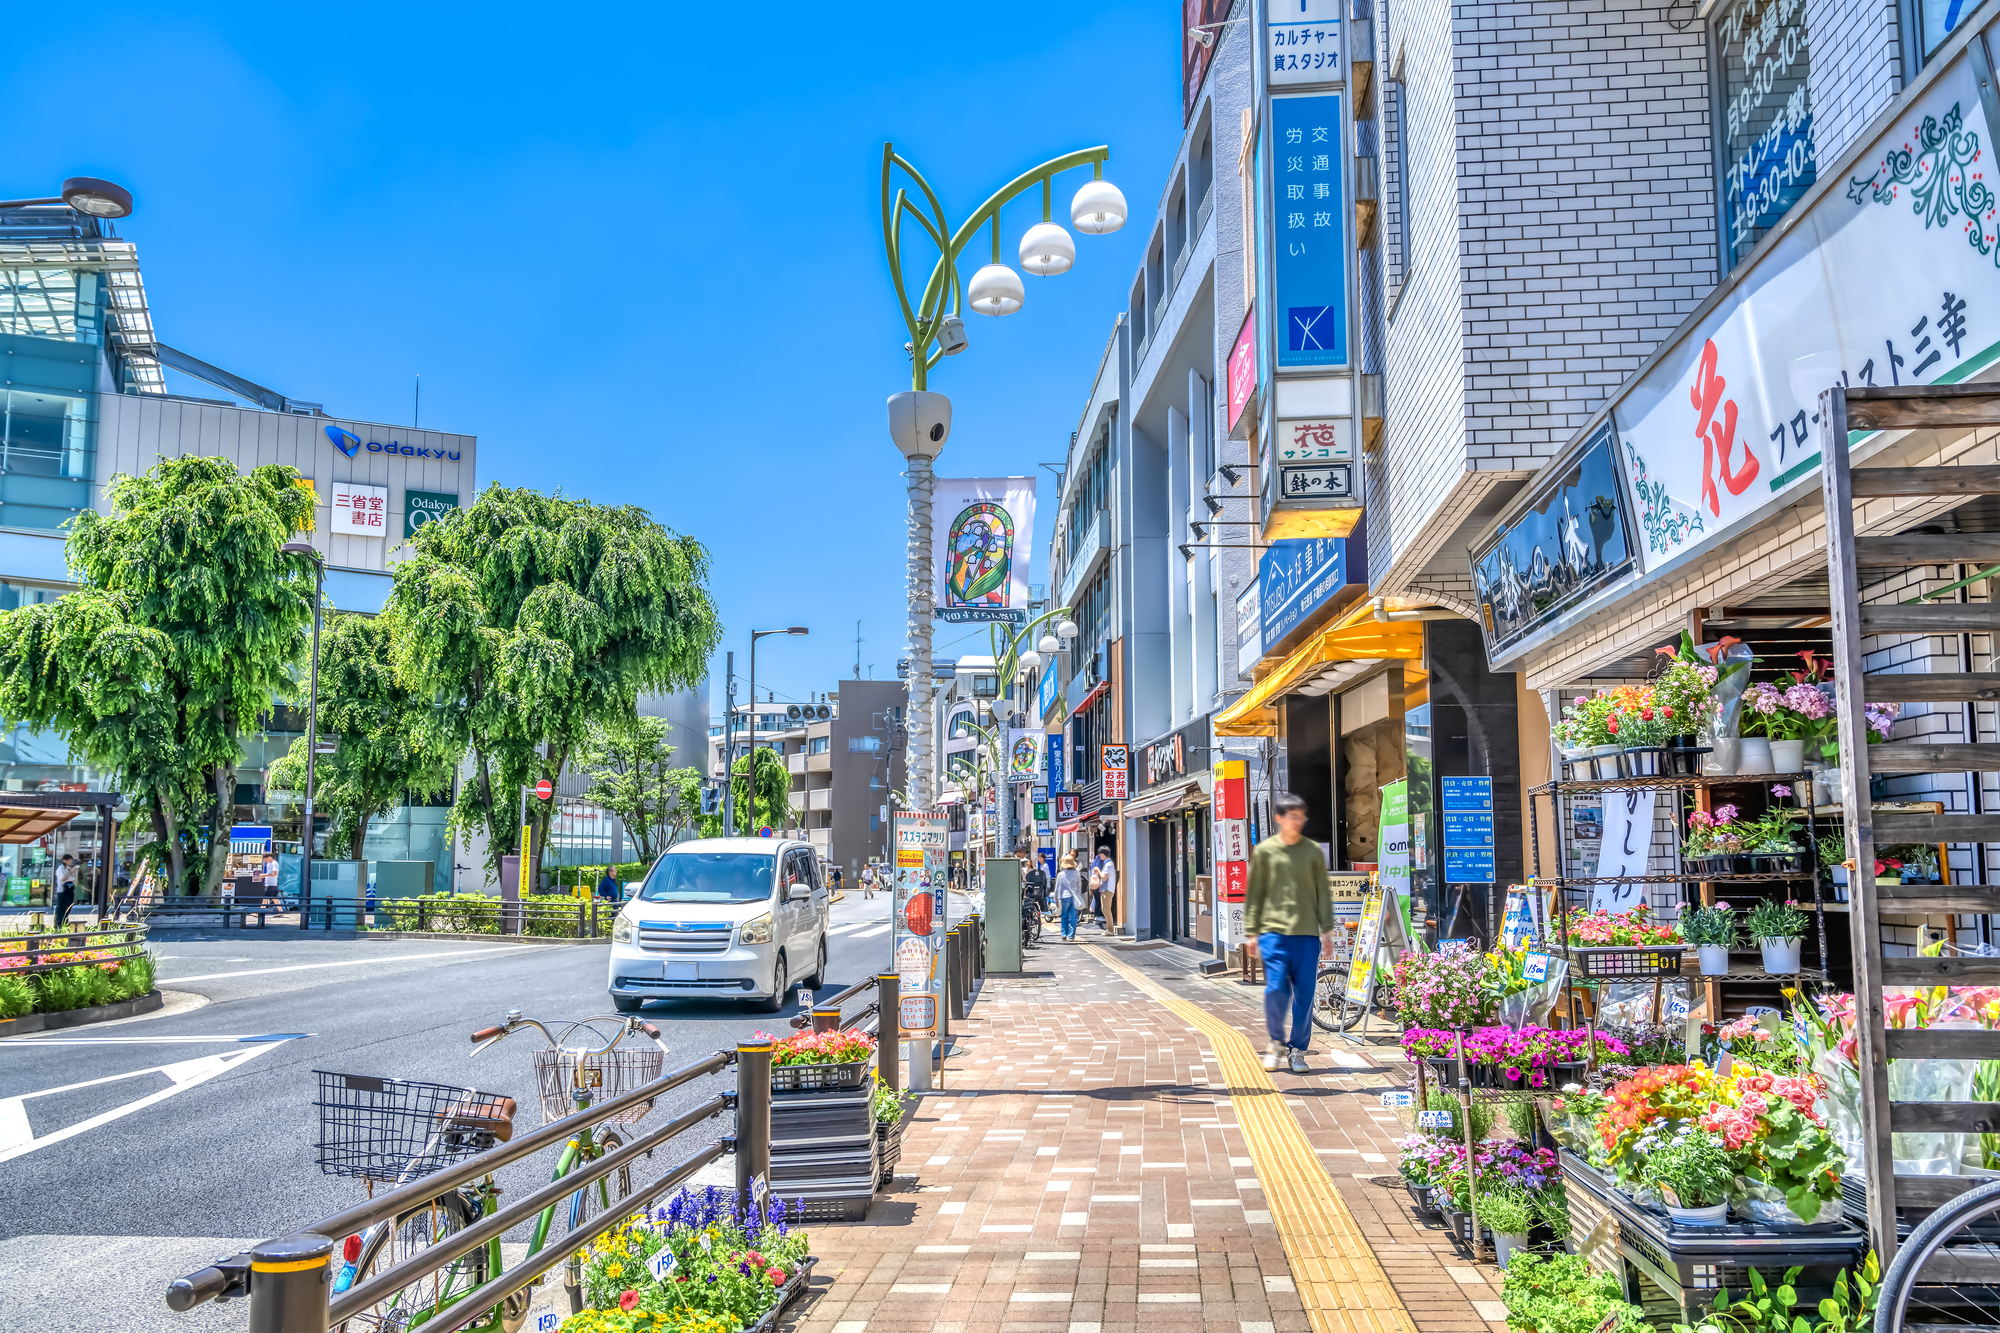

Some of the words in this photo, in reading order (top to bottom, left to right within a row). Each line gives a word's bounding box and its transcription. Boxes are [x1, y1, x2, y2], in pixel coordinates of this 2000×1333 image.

[1275, 29, 1337, 46] カルチャー
[1274, 51, 1338, 72] 貸スタジオ
[1311, 126, 1331, 227] 交通事故
[1286, 127, 1306, 256] 労災取扱い
[1293, 423, 1337, 448] 花
[1690, 338, 1760, 518] 花
[366, 440, 461, 462] odakyu
[1284, 449, 1348, 458] サンコー
[1290, 470, 1343, 492] 鉢の木
[335, 493, 384, 511] 三省堂
[411, 497, 453, 511] Odakyu
[351, 510, 383, 527] 書店
[1104, 771, 1115, 798] お惣菜
[1116, 771, 1126, 798] お弁当
[904, 831, 945, 843] スズランマツリ
[1231, 824, 1242, 857] 創作料理
[1660, 956, 1676, 969] 01
[839, 1069, 852, 1081] 01
